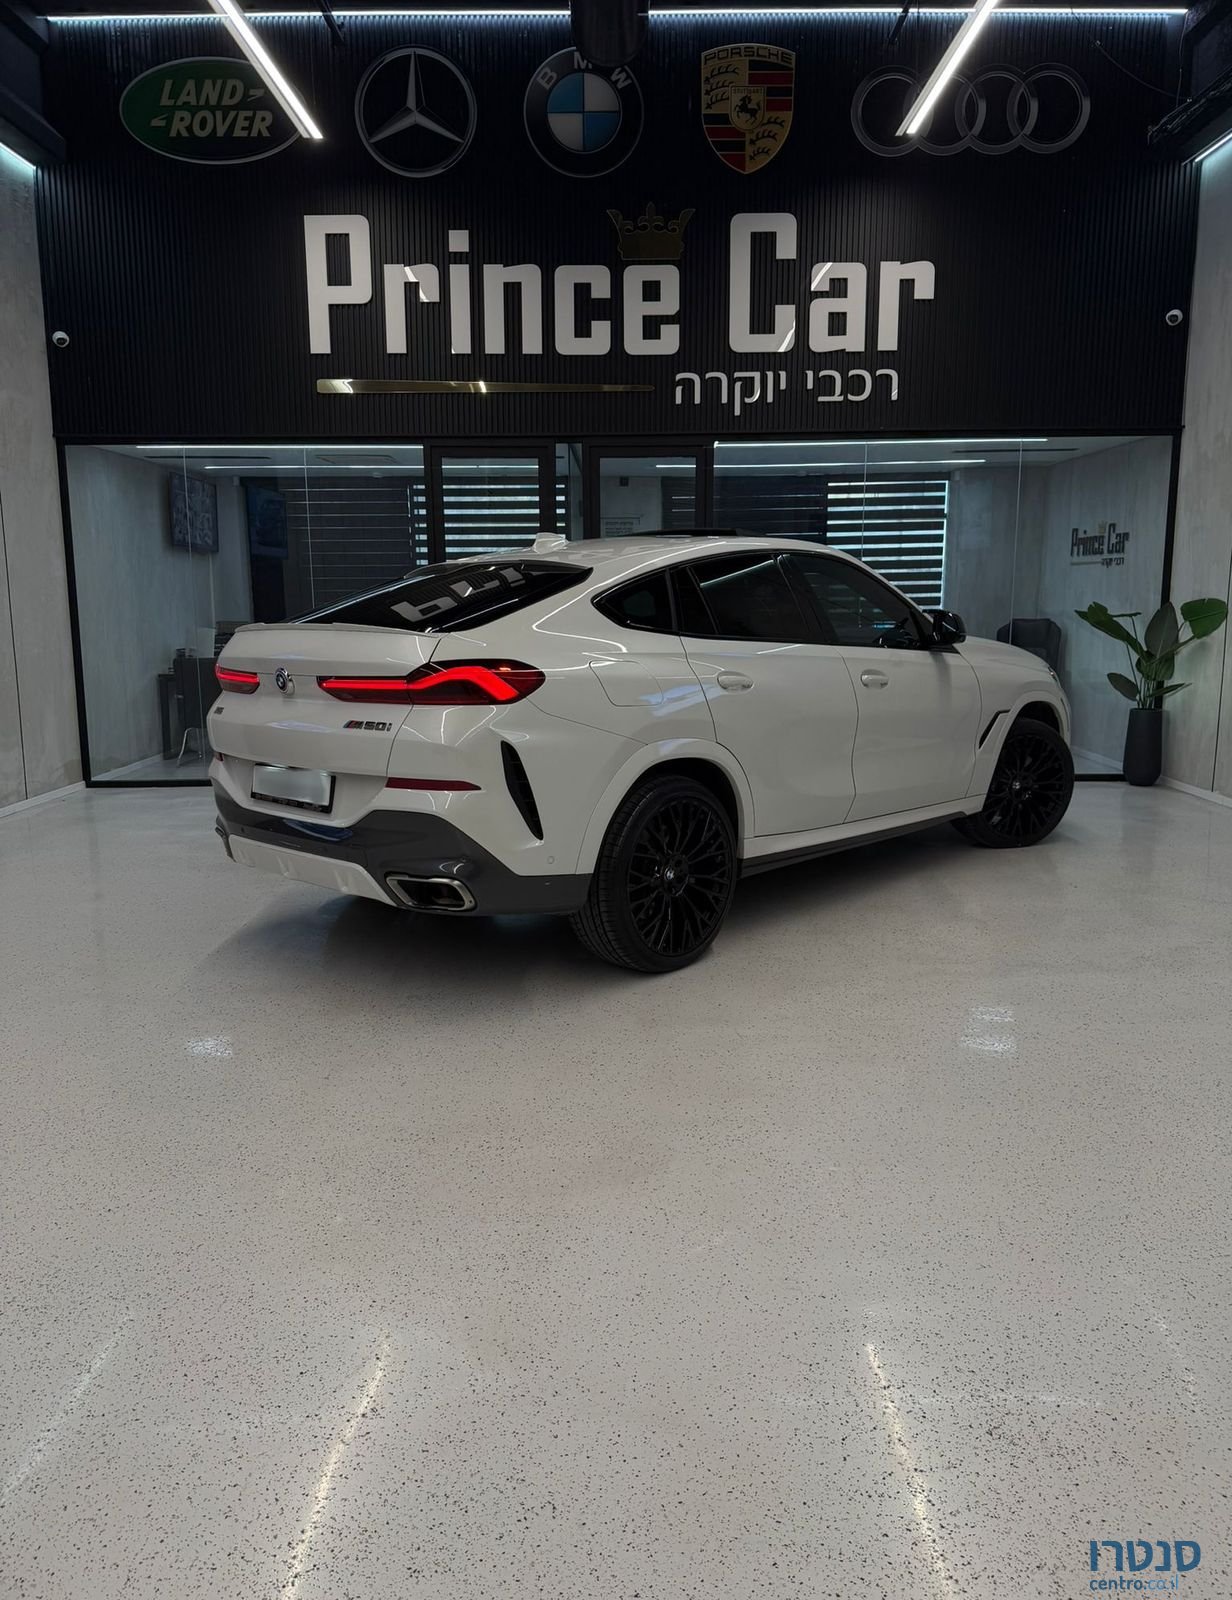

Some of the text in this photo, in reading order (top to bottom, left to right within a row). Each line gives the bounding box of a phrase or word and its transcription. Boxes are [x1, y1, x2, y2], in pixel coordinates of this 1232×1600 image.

[704, 46, 794, 66] PORSCHE
[160, 79, 245, 106] LAND
[169, 110, 273, 137] ROVER
[303, 212, 935, 355] Prince Car
[675, 369, 899, 416] רכבי יוקרה
[1071, 523, 1130, 557] Prince Car
